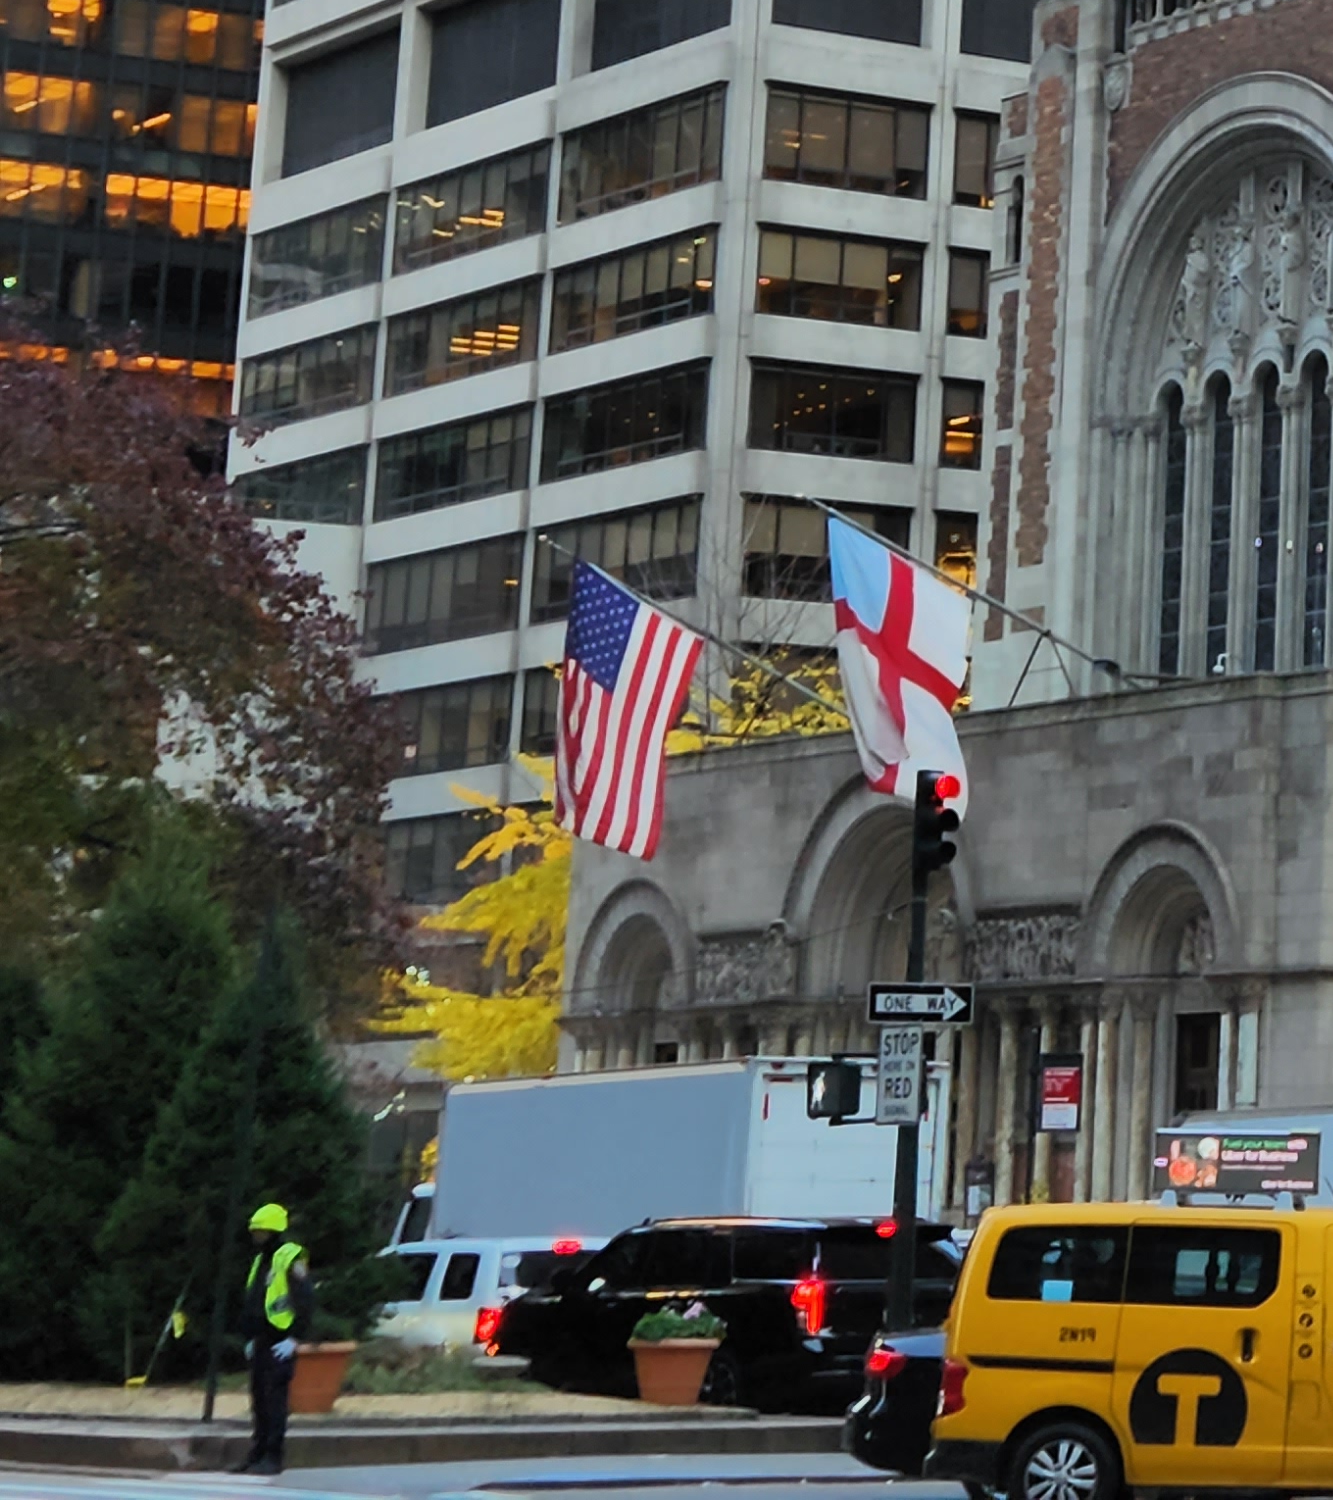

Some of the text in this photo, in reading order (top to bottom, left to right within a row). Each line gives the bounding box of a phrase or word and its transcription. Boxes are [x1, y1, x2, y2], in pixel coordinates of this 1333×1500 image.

[883, 995, 957, 1011] ONE WAY
[883, 1032, 919, 1056] STOP
[884, 1077, 912, 1099] RED
[1156, 1374, 1223, 1446] T
